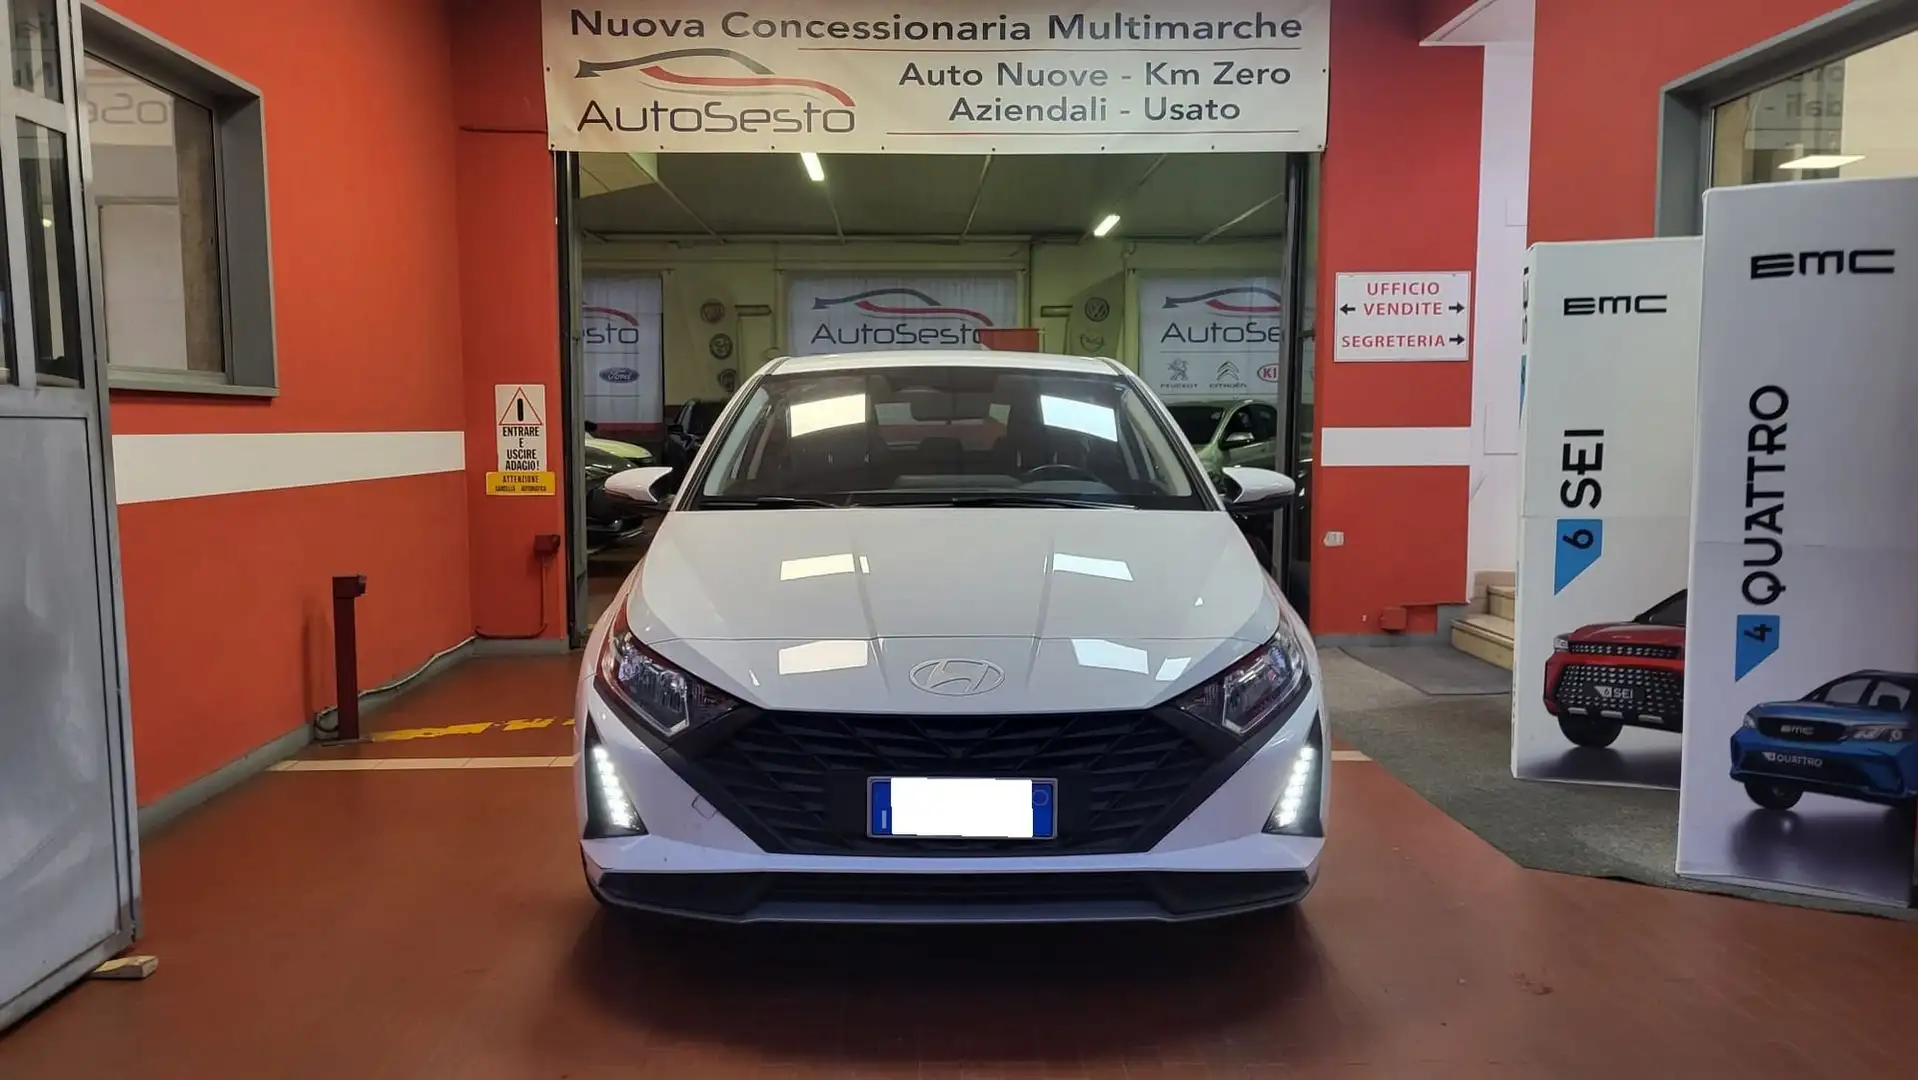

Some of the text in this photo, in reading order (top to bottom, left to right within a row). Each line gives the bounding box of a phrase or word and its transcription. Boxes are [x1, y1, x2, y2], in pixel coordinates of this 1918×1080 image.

[571, 9, 1302, 41] Nuova Concessionaria Multimarche
[899, 62, 983, 86] Auto
[997, 62, 1108, 86] Nuove
[1145, 62, 1200, 85] Km
[1213, 62, 1291, 85] Zero
[949, 97, 1107, 121] Aziendali
[1144, 97, 1241, 121] Usato
[577, 100, 855, 133] AutoSesto
[1367, 282, 1440, 296] UFFICIO
[1364, 302, 1443, 316] VENDITE
[582, 322, 639, 344] sto
[1161, 322, 1280, 343] AutoSe
[1341, 335, 1446, 348] SEGRETERIA
[1263, 368, 1277, 379] KI
[502, 426, 540, 437] ENTRARE
[518, 438, 525, 448] E
[506, 449, 537, 460] USCIRE
[505, 460, 540, 471] ADAGIO!
[1560, 429, 1604, 549] 6 SEI
[1742, 385, 1789, 642] 4 QUATTRO
[1613, 688, 1634, 699] SEI
